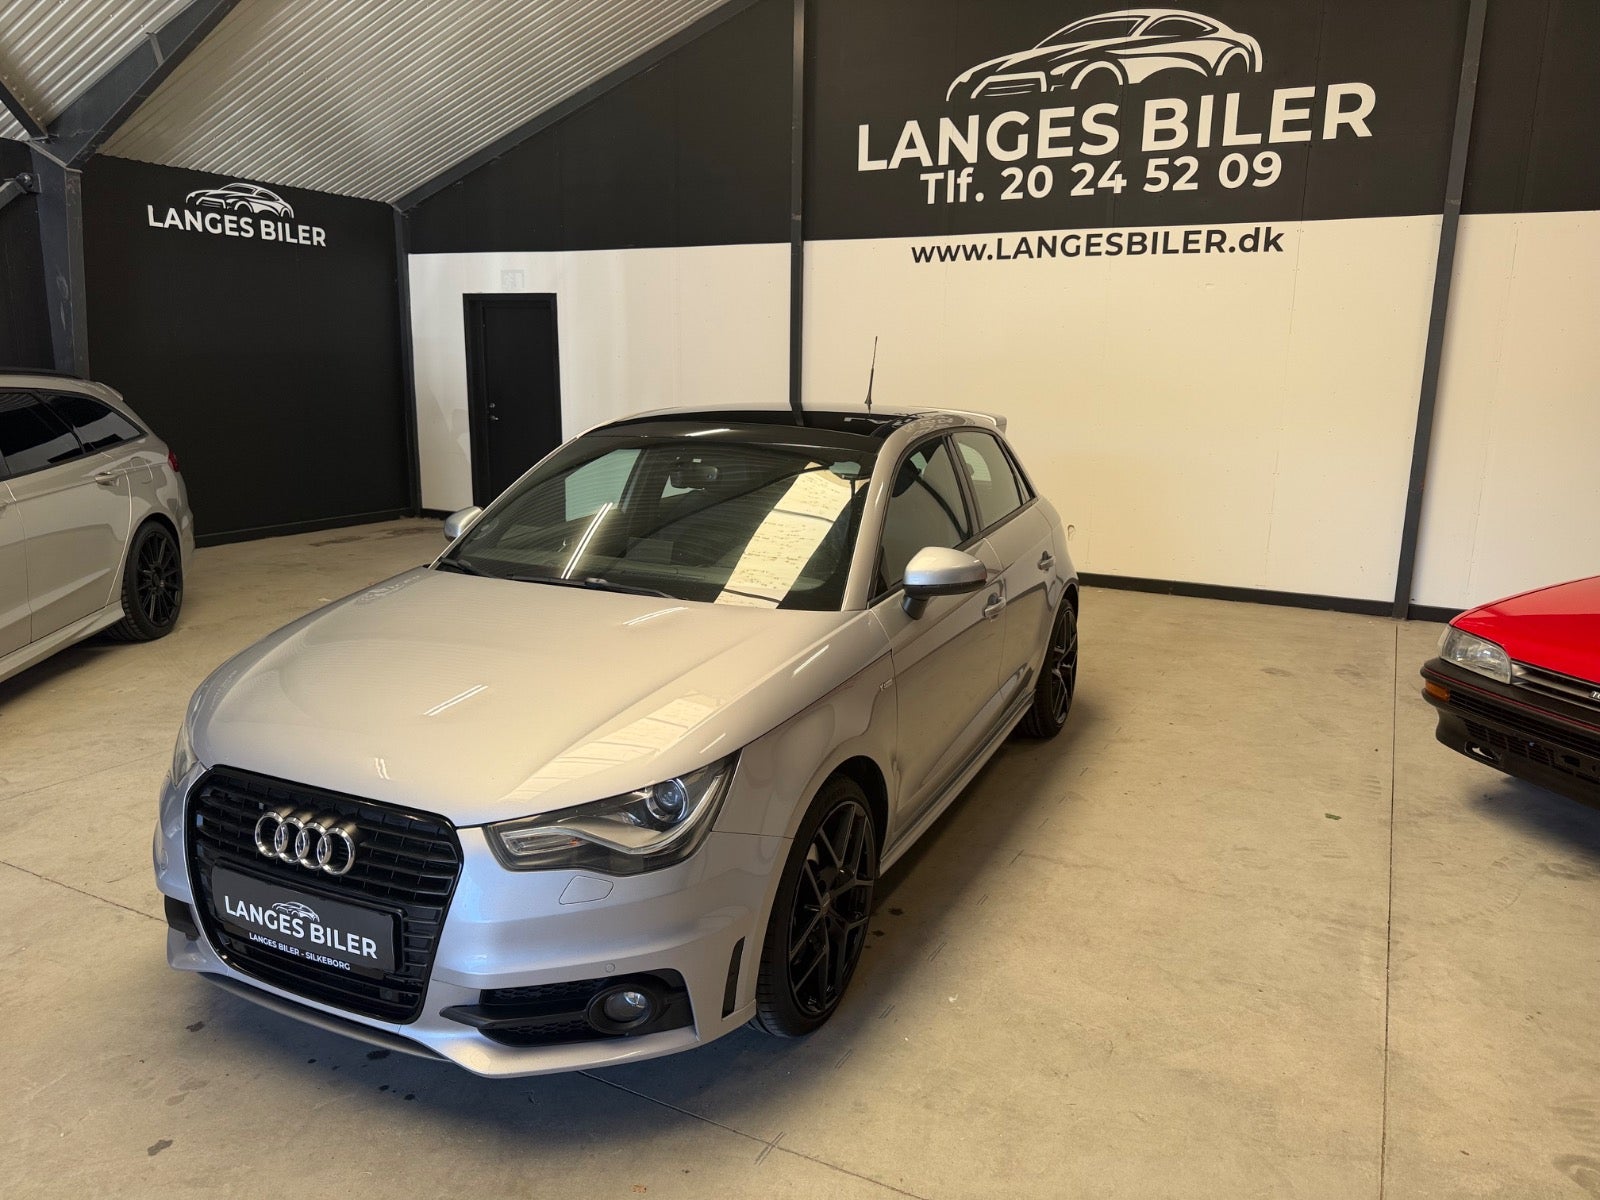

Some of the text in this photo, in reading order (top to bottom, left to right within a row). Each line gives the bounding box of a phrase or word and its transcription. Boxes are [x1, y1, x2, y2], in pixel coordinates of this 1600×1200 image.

[857, 82, 1377, 172] LANGES BILER
[920, 151, 1282, 205] Tlf. 20 24 52 09
[147, 204, 326, 247] LANGES BILER
[911, 226, 1285, 263] www.LANGESBILER.dk
[224, 895, 378, 960] LANGES BILER
[249, 932, 277, 949] LANGES
[278, 942, 300, 957] BILER
[305, 951, 351, 971] SILKEBORG
